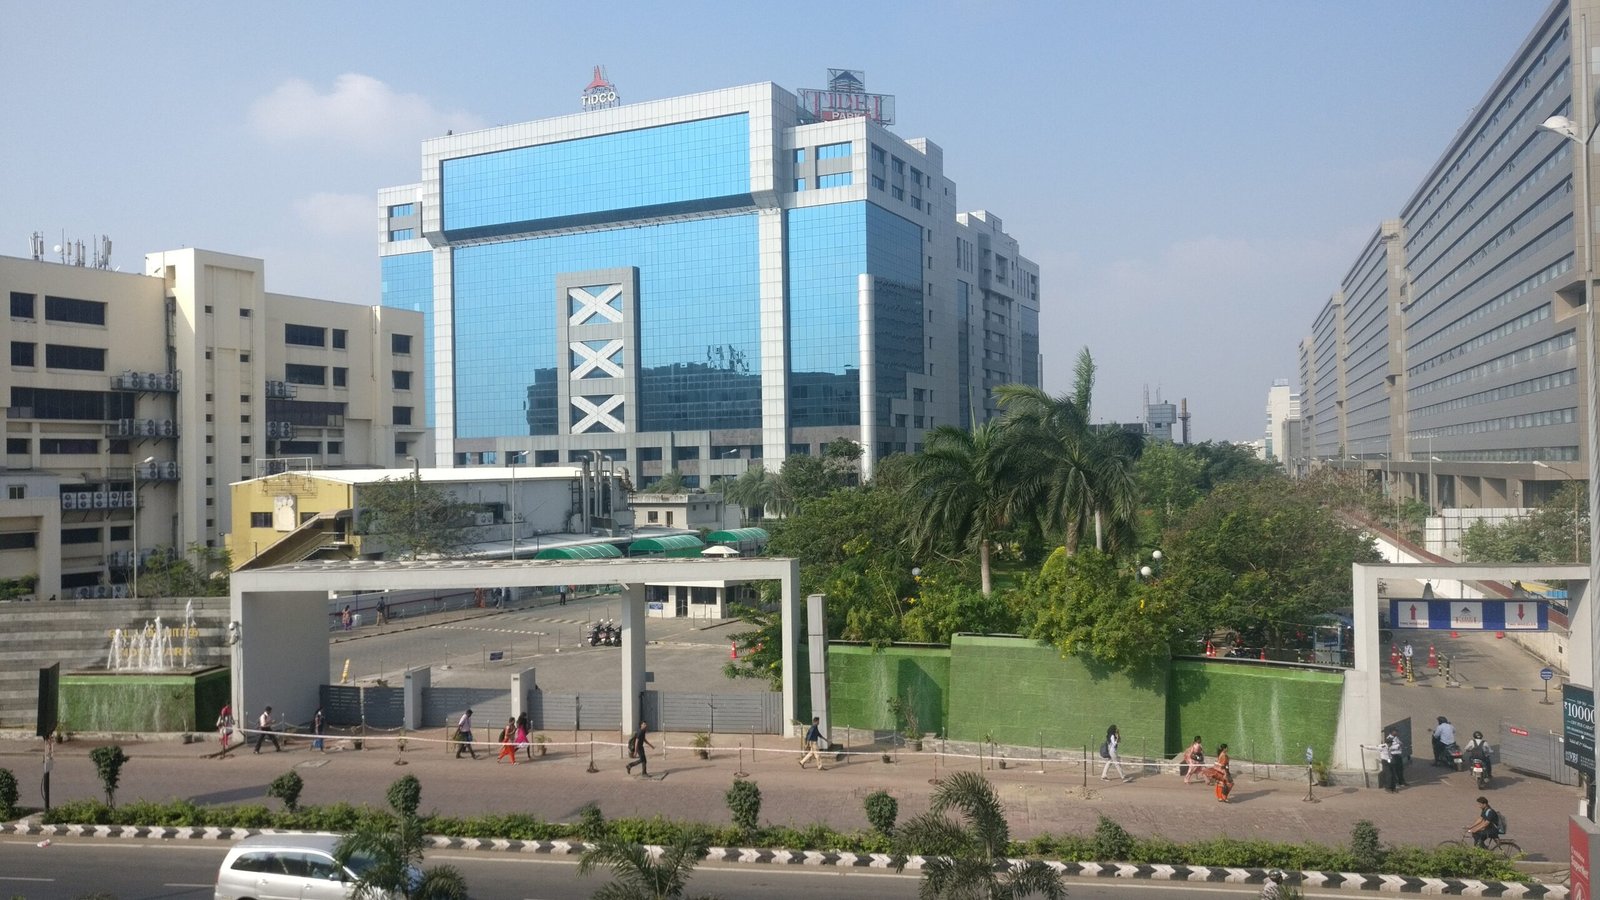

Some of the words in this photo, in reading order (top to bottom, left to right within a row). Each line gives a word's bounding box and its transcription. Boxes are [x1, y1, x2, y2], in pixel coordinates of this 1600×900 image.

[581, 91, 616, 105] TIDCO
[804, 90, 891, 122] TIDEL
[831, 112, 862, 120] PARK
